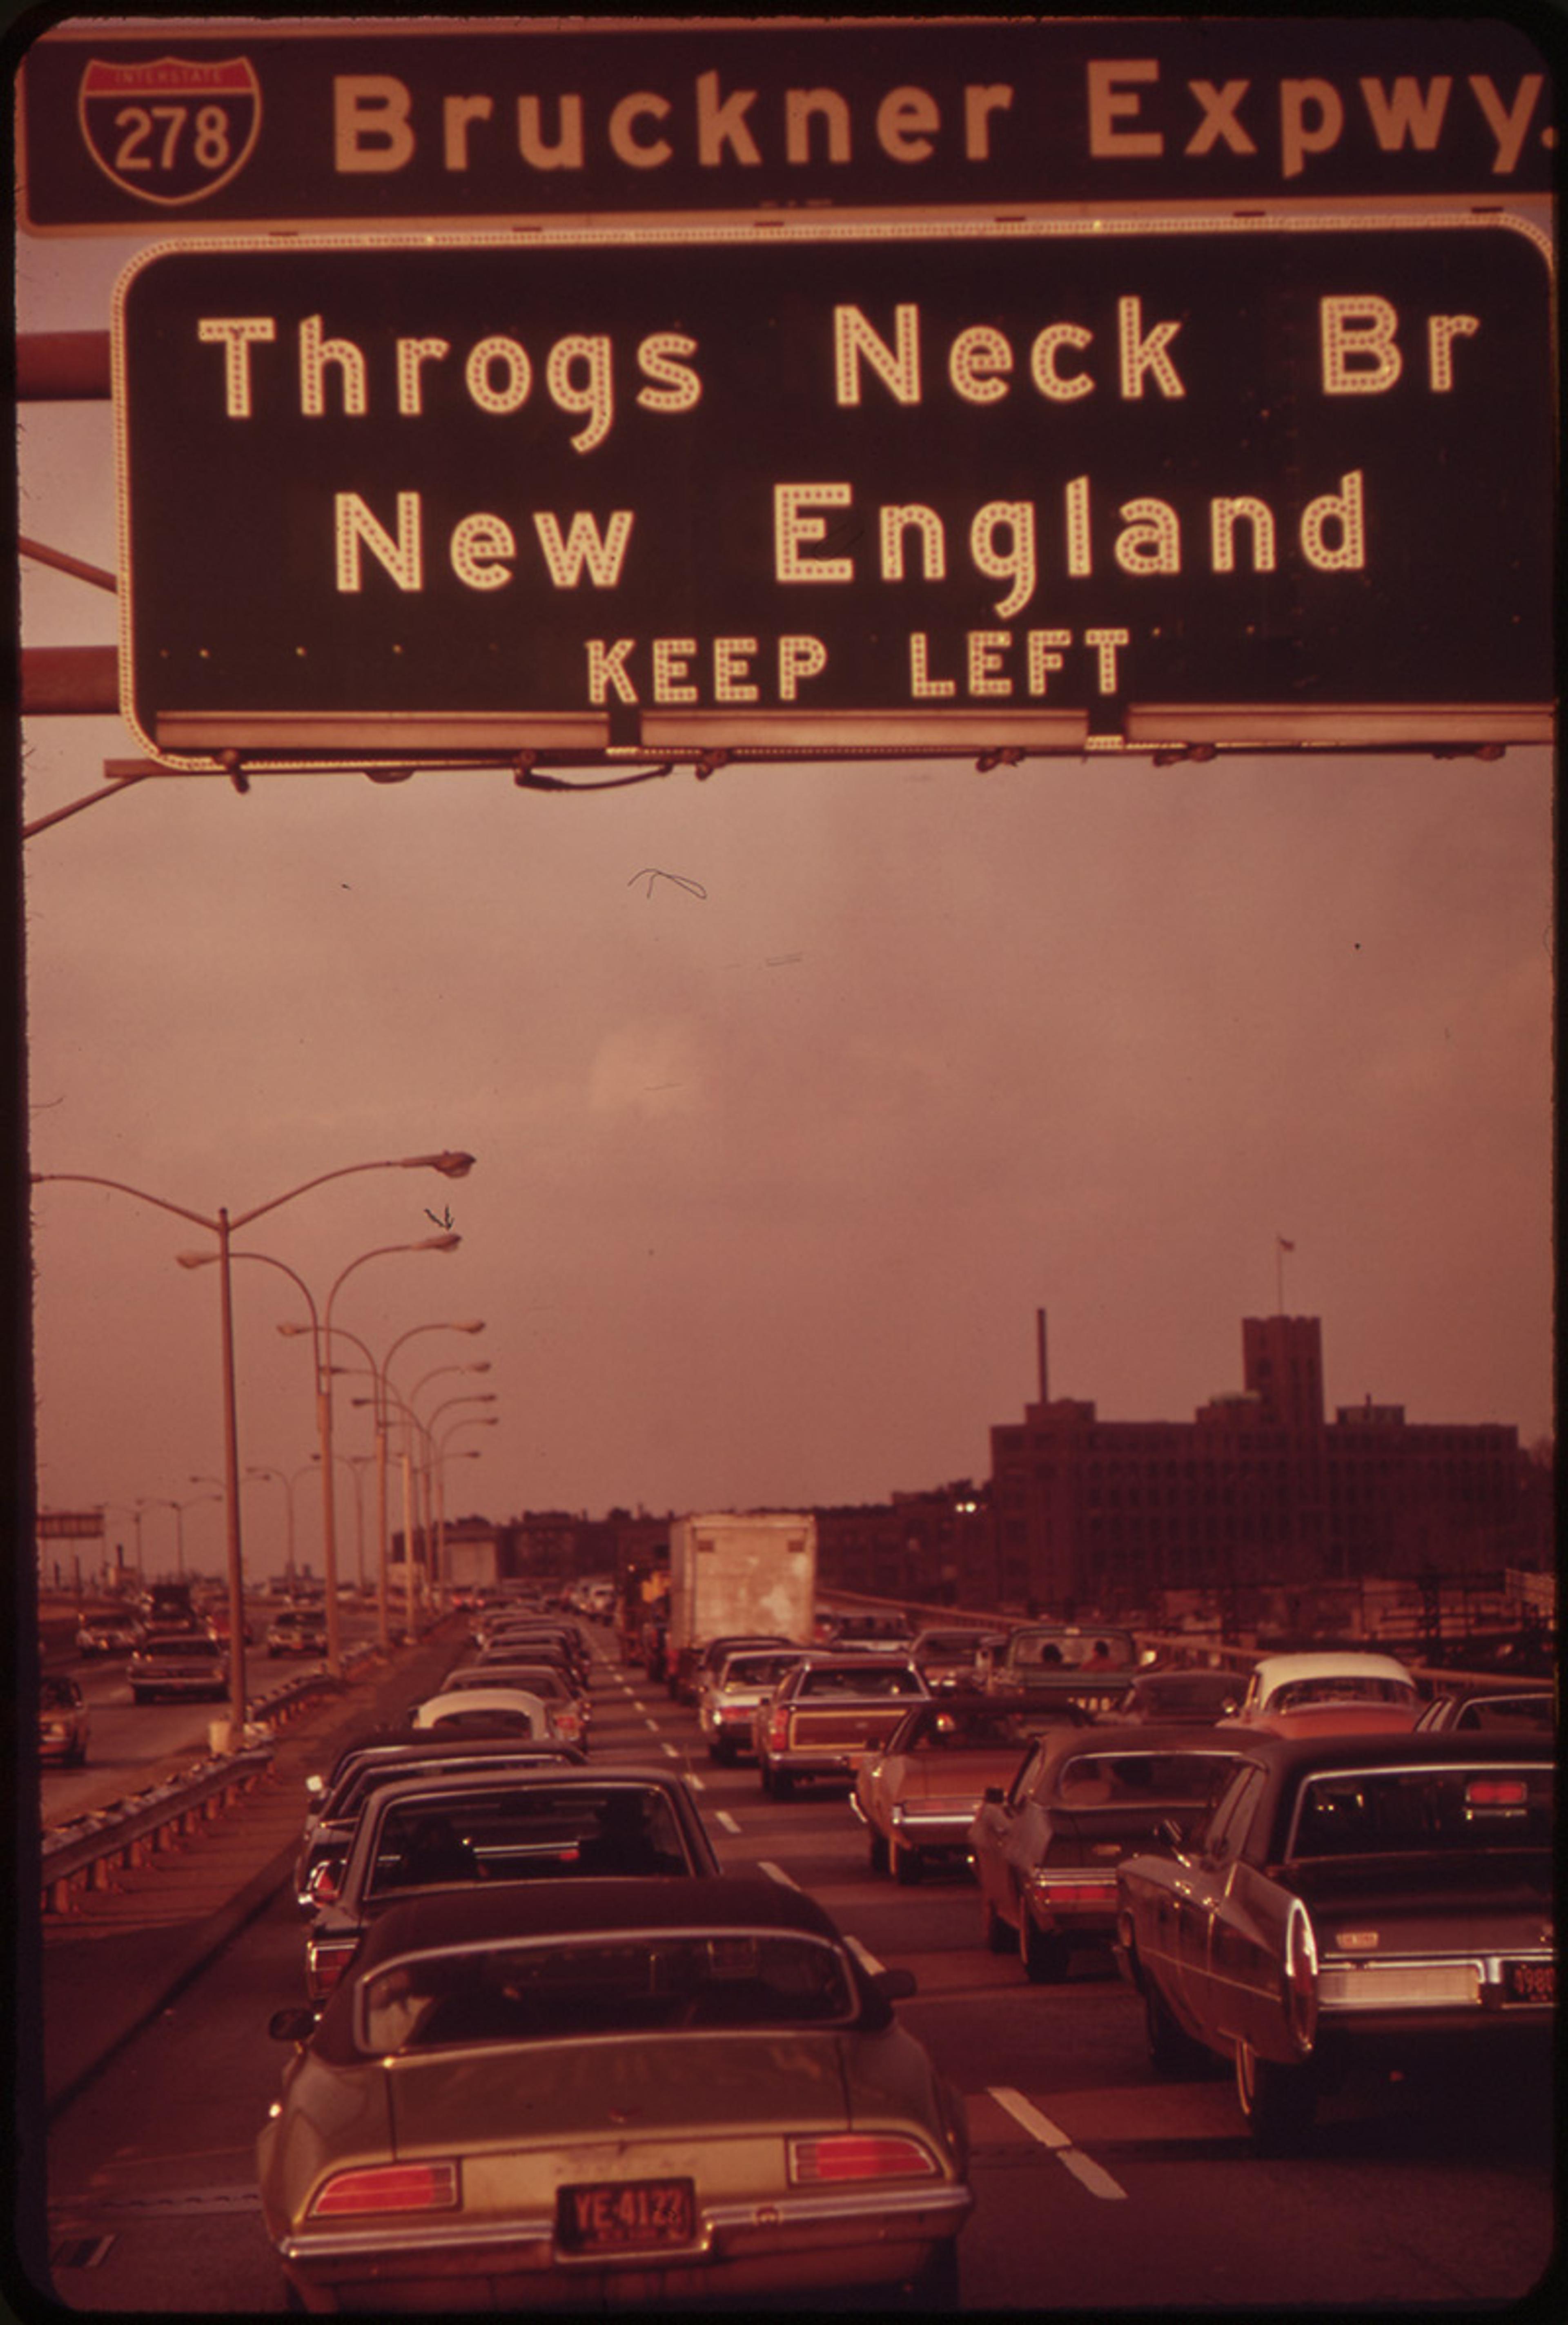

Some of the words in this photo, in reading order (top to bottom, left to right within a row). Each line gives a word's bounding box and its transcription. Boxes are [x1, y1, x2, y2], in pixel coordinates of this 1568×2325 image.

[116, 106, 230, 169] 278
[334, 71, 1013, 173] Bruckner
[1088, 60, 1556, 177] Expwy.
[198, 315, 702, 453] Throgs
[834, 296, 1185, 406] Neck
[1321, 295, 1479, 395] Br
[335, 491, 635, 593] New
[774, 470, 1365, 620] England
[586, 635, 828, 705] KEEP
[910, 628, 1129, 698] LEFT
